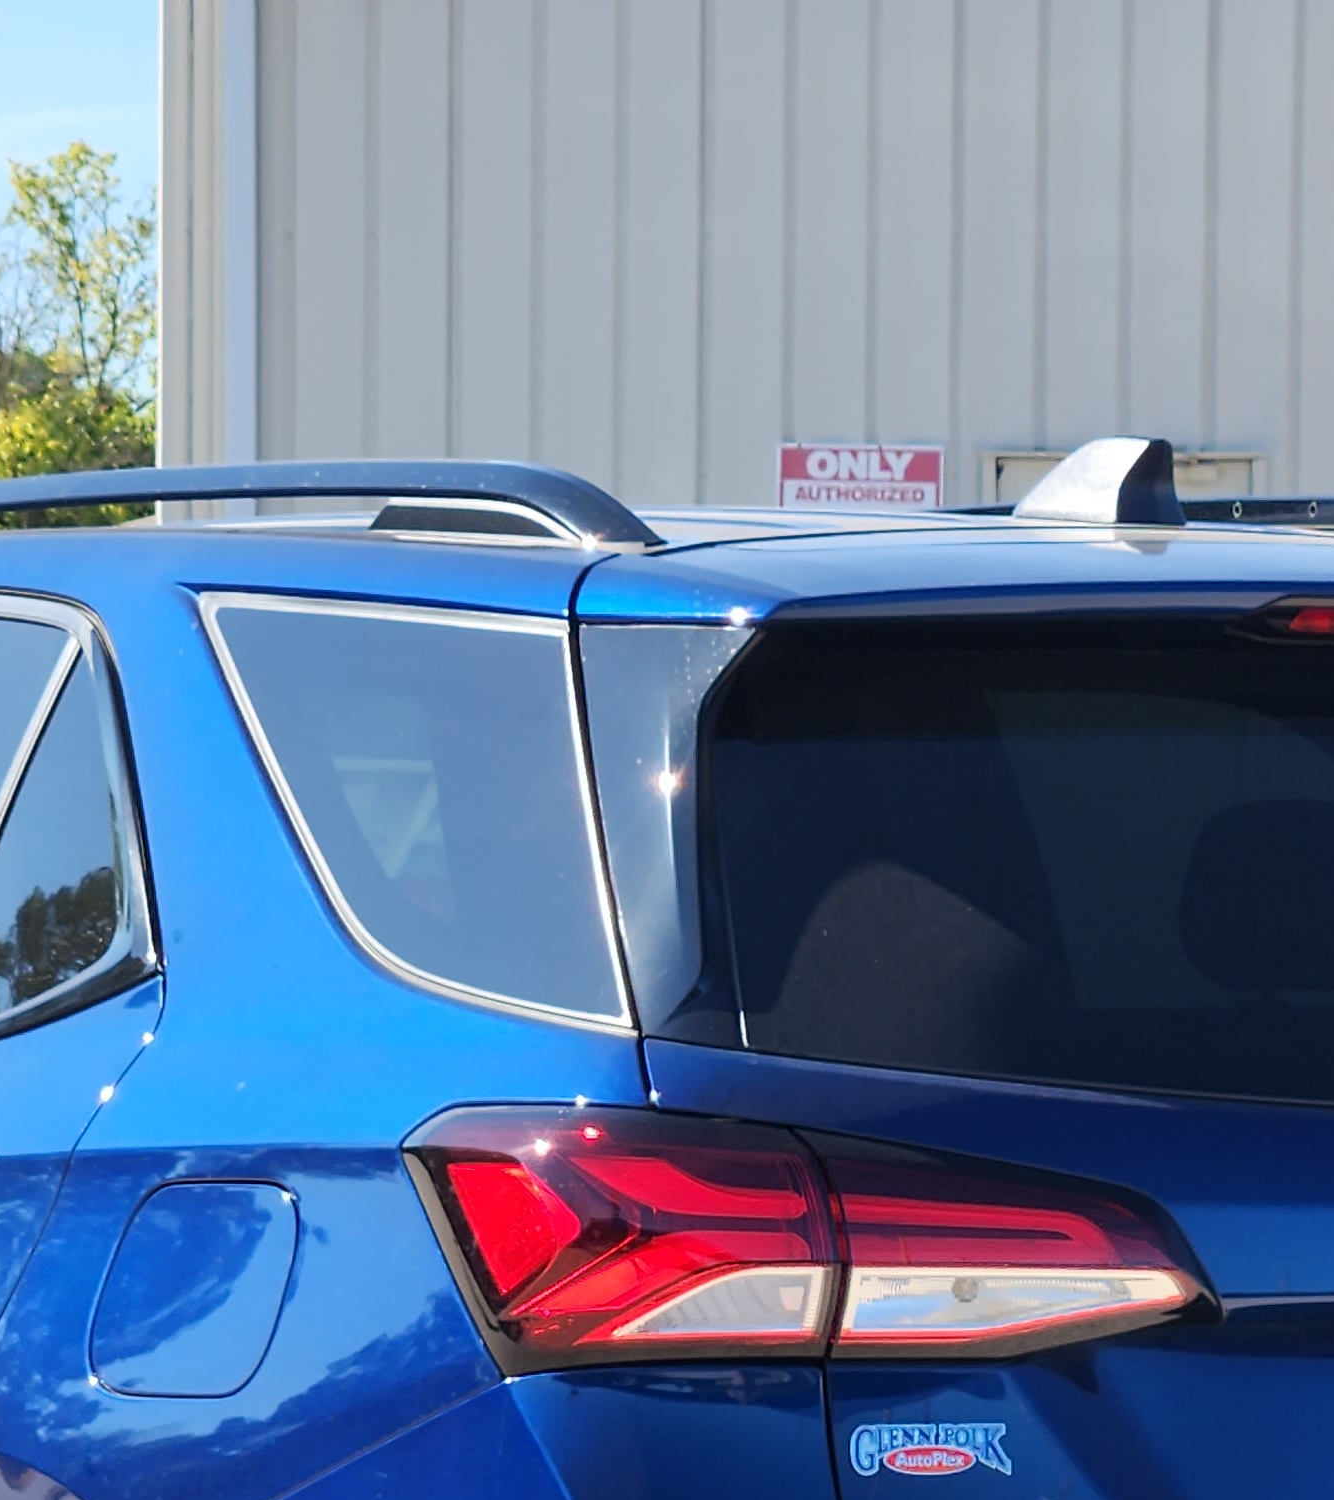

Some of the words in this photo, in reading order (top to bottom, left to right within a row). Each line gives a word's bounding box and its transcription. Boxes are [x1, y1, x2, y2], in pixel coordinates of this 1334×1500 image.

[806, 449, 914, 482] ONLY
[795, 485, 925, 503] AUTHORIZED
[854, 1425, 935, 1471] GLENN
[940, 1425, 1010, 1473] POLK
[894, 1452, 965, 1468] AutoPlex
